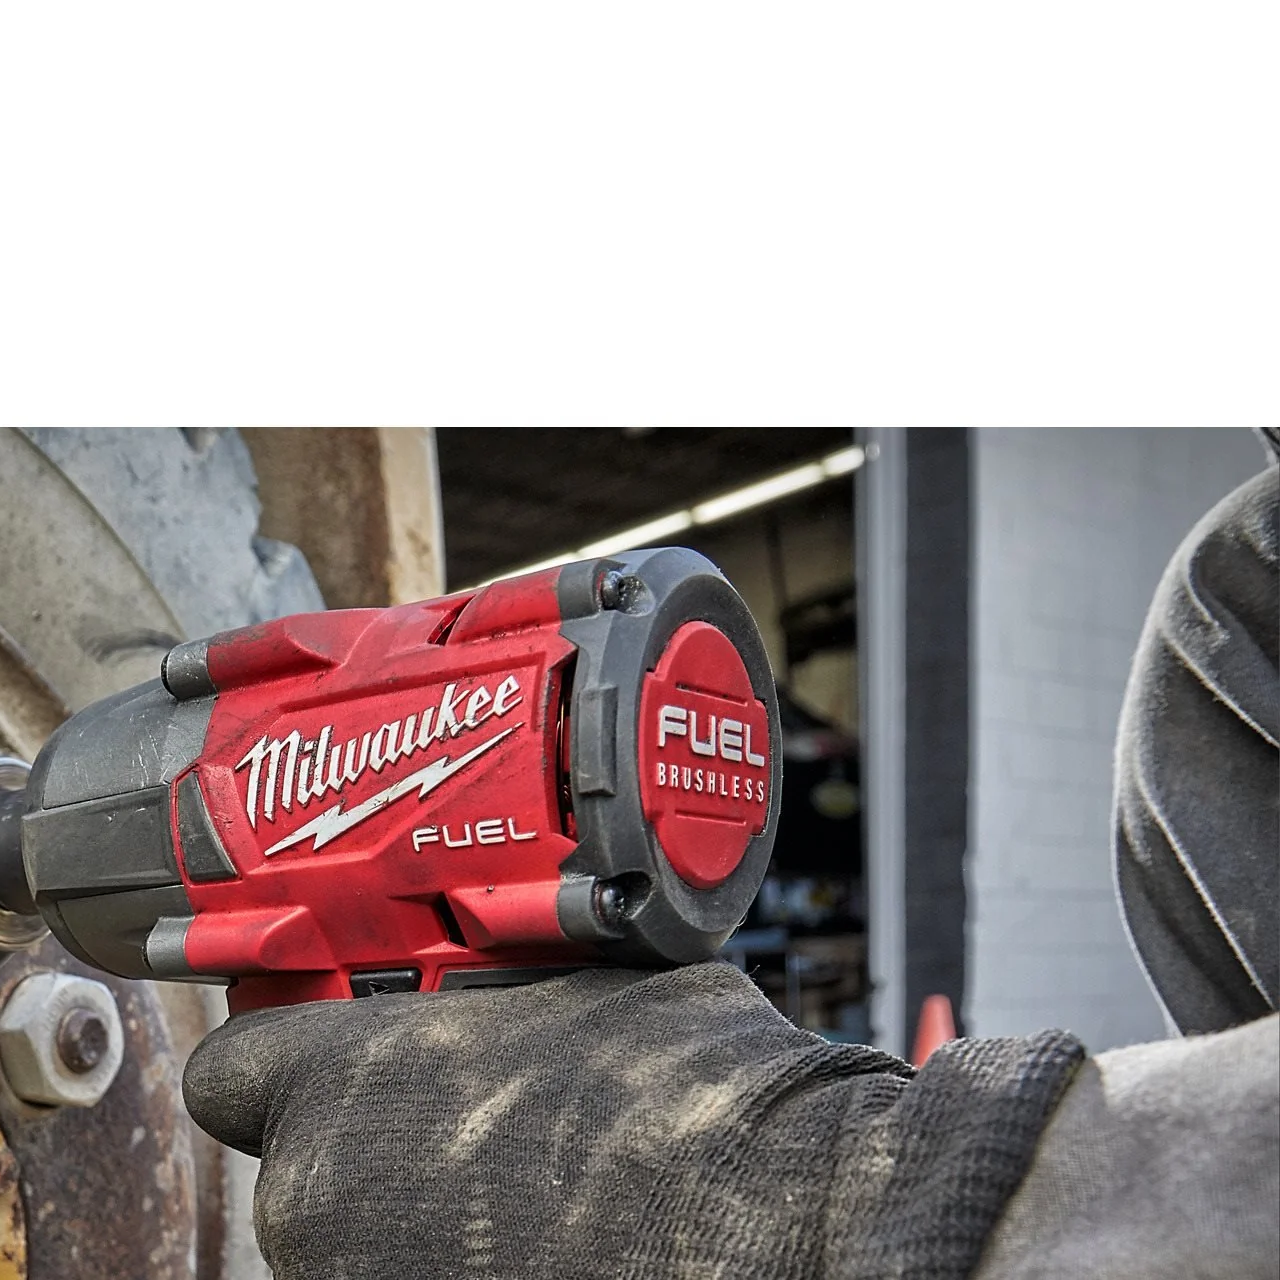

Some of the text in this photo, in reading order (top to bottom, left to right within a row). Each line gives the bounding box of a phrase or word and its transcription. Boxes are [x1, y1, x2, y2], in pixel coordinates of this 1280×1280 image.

[235, 675, 523, 829] Milwaukee
[656, 704, 765, 767] FUEL
[656, 762, 764, 802] BRUSHLESS
[412, 817, 537, 852] FUEL
